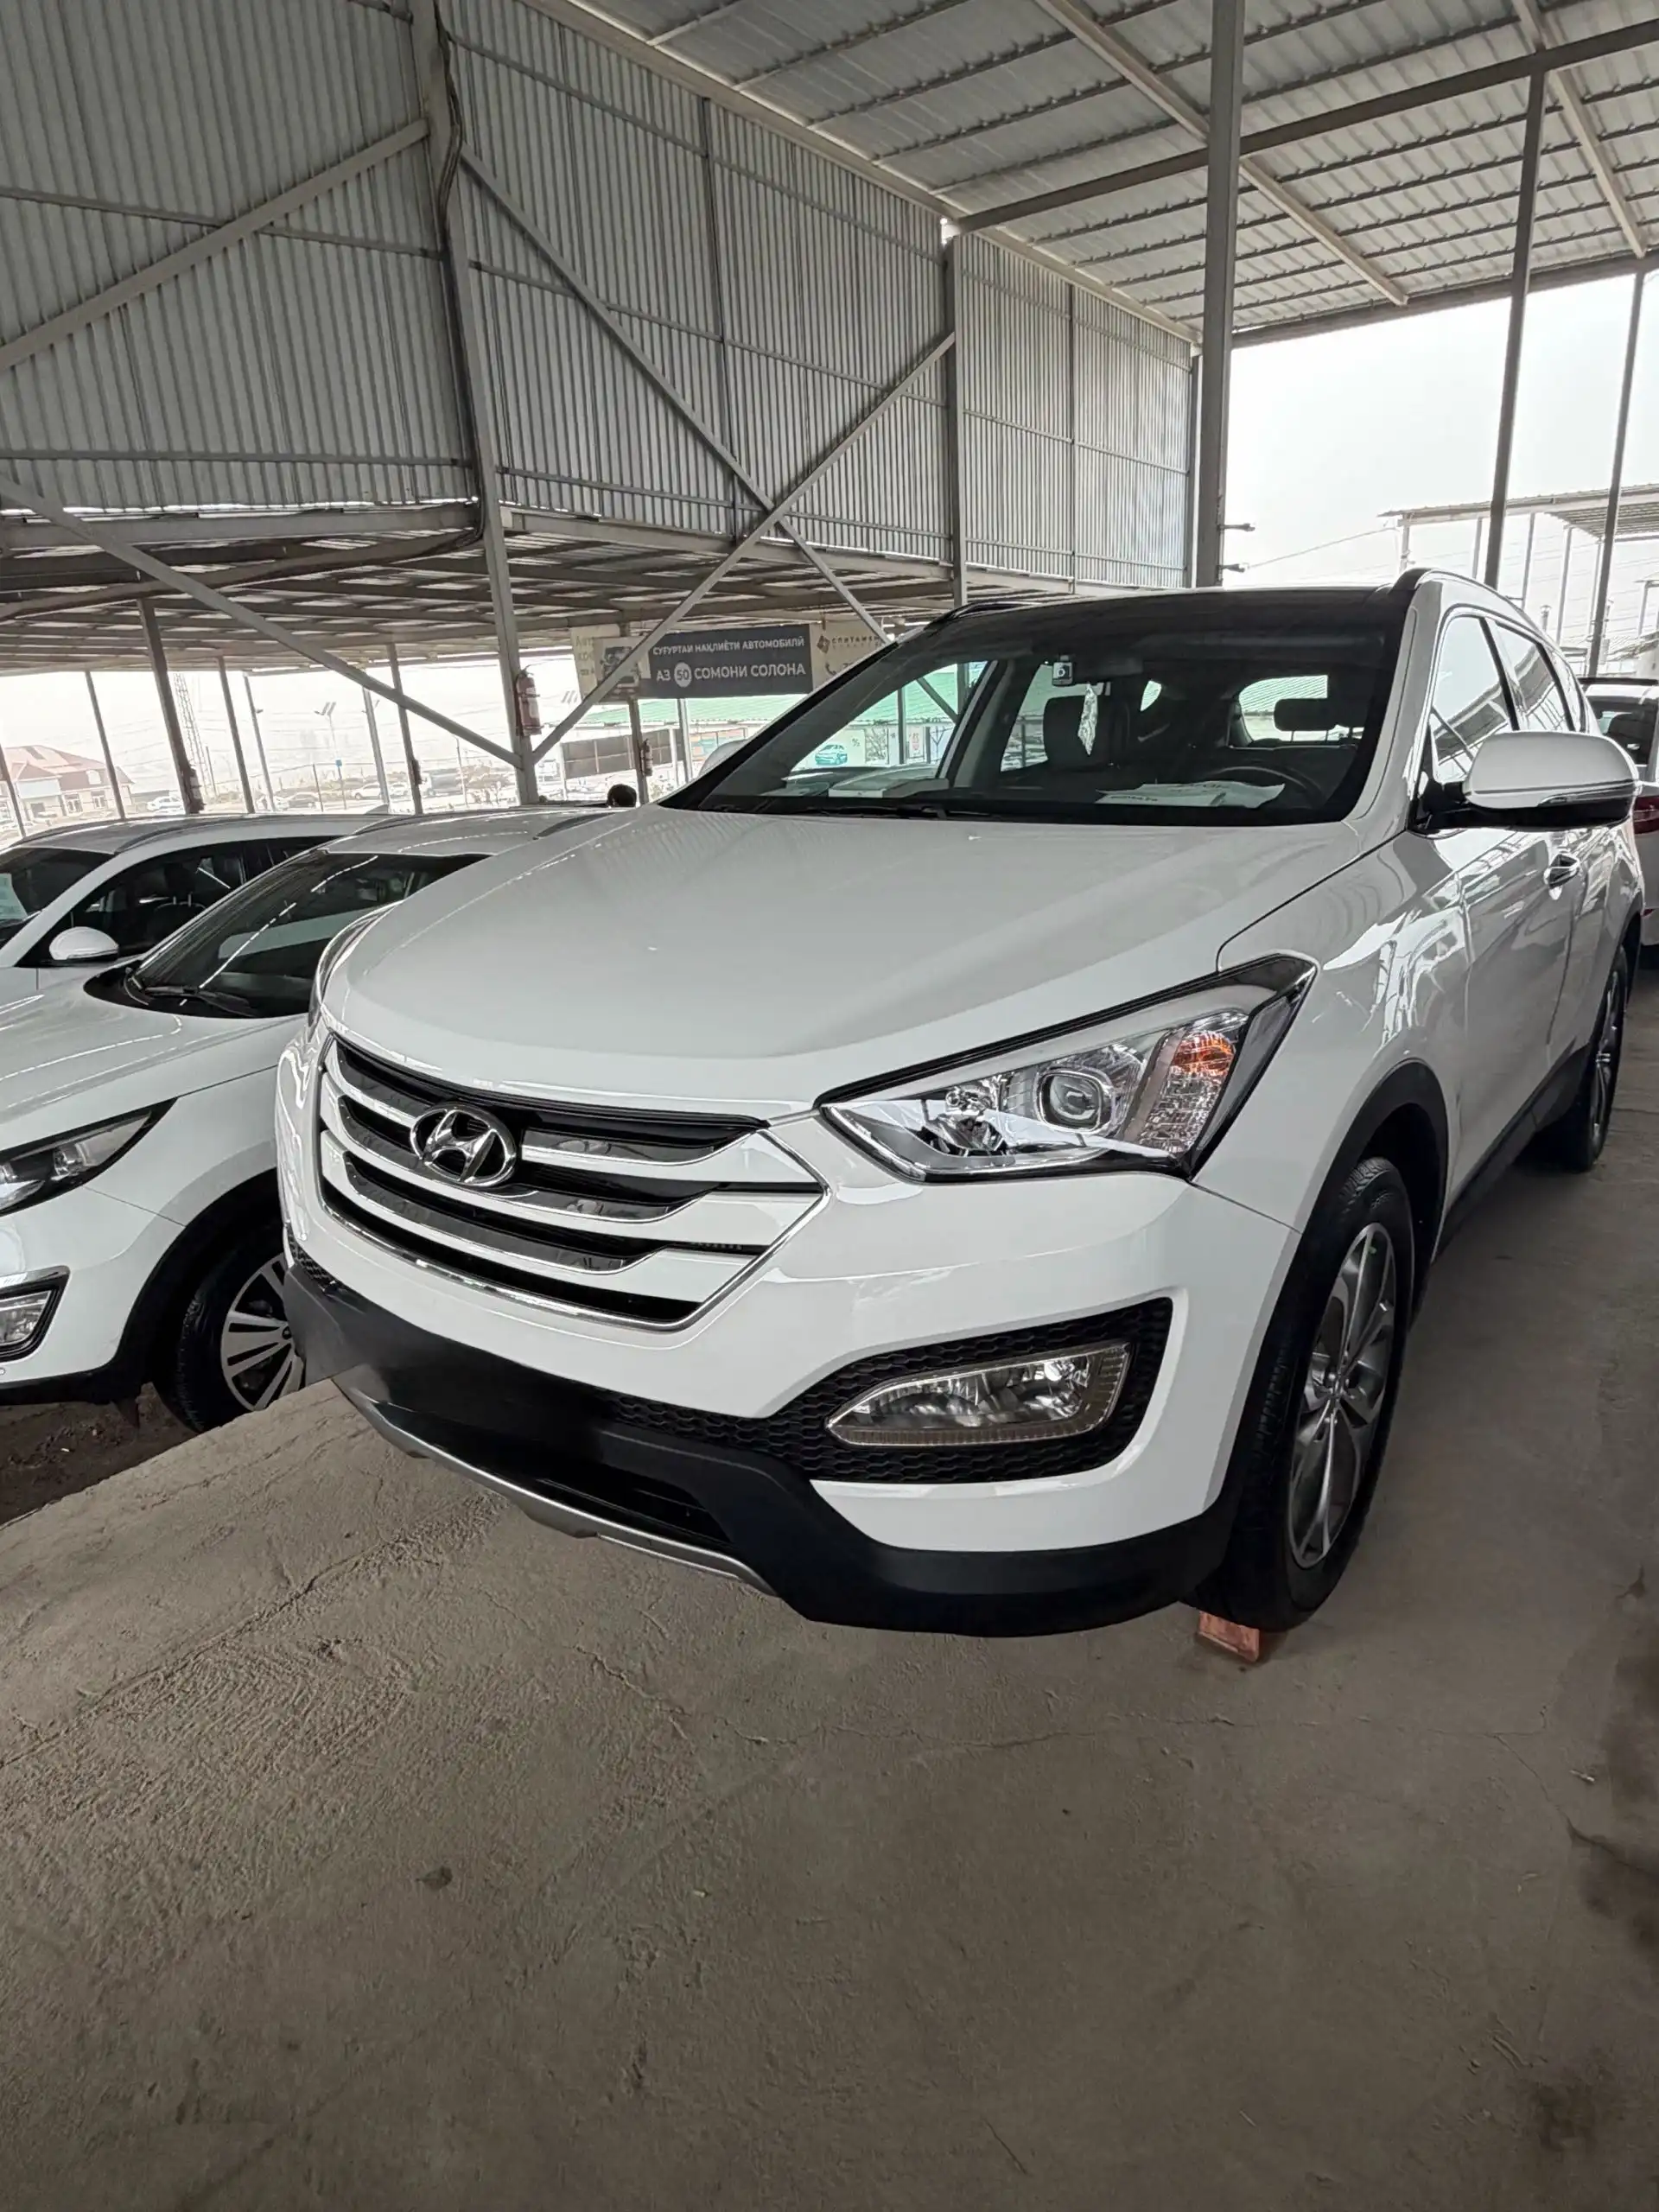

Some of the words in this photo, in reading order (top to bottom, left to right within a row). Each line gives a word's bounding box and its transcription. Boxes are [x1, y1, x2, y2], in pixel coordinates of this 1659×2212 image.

[656, 670, 671, 681] АЗ
[677, 667, 688, 681] 50
[694, 665, 747, 679] СОМОНИ
[751, 663, 806, 677] СОЛОНА
